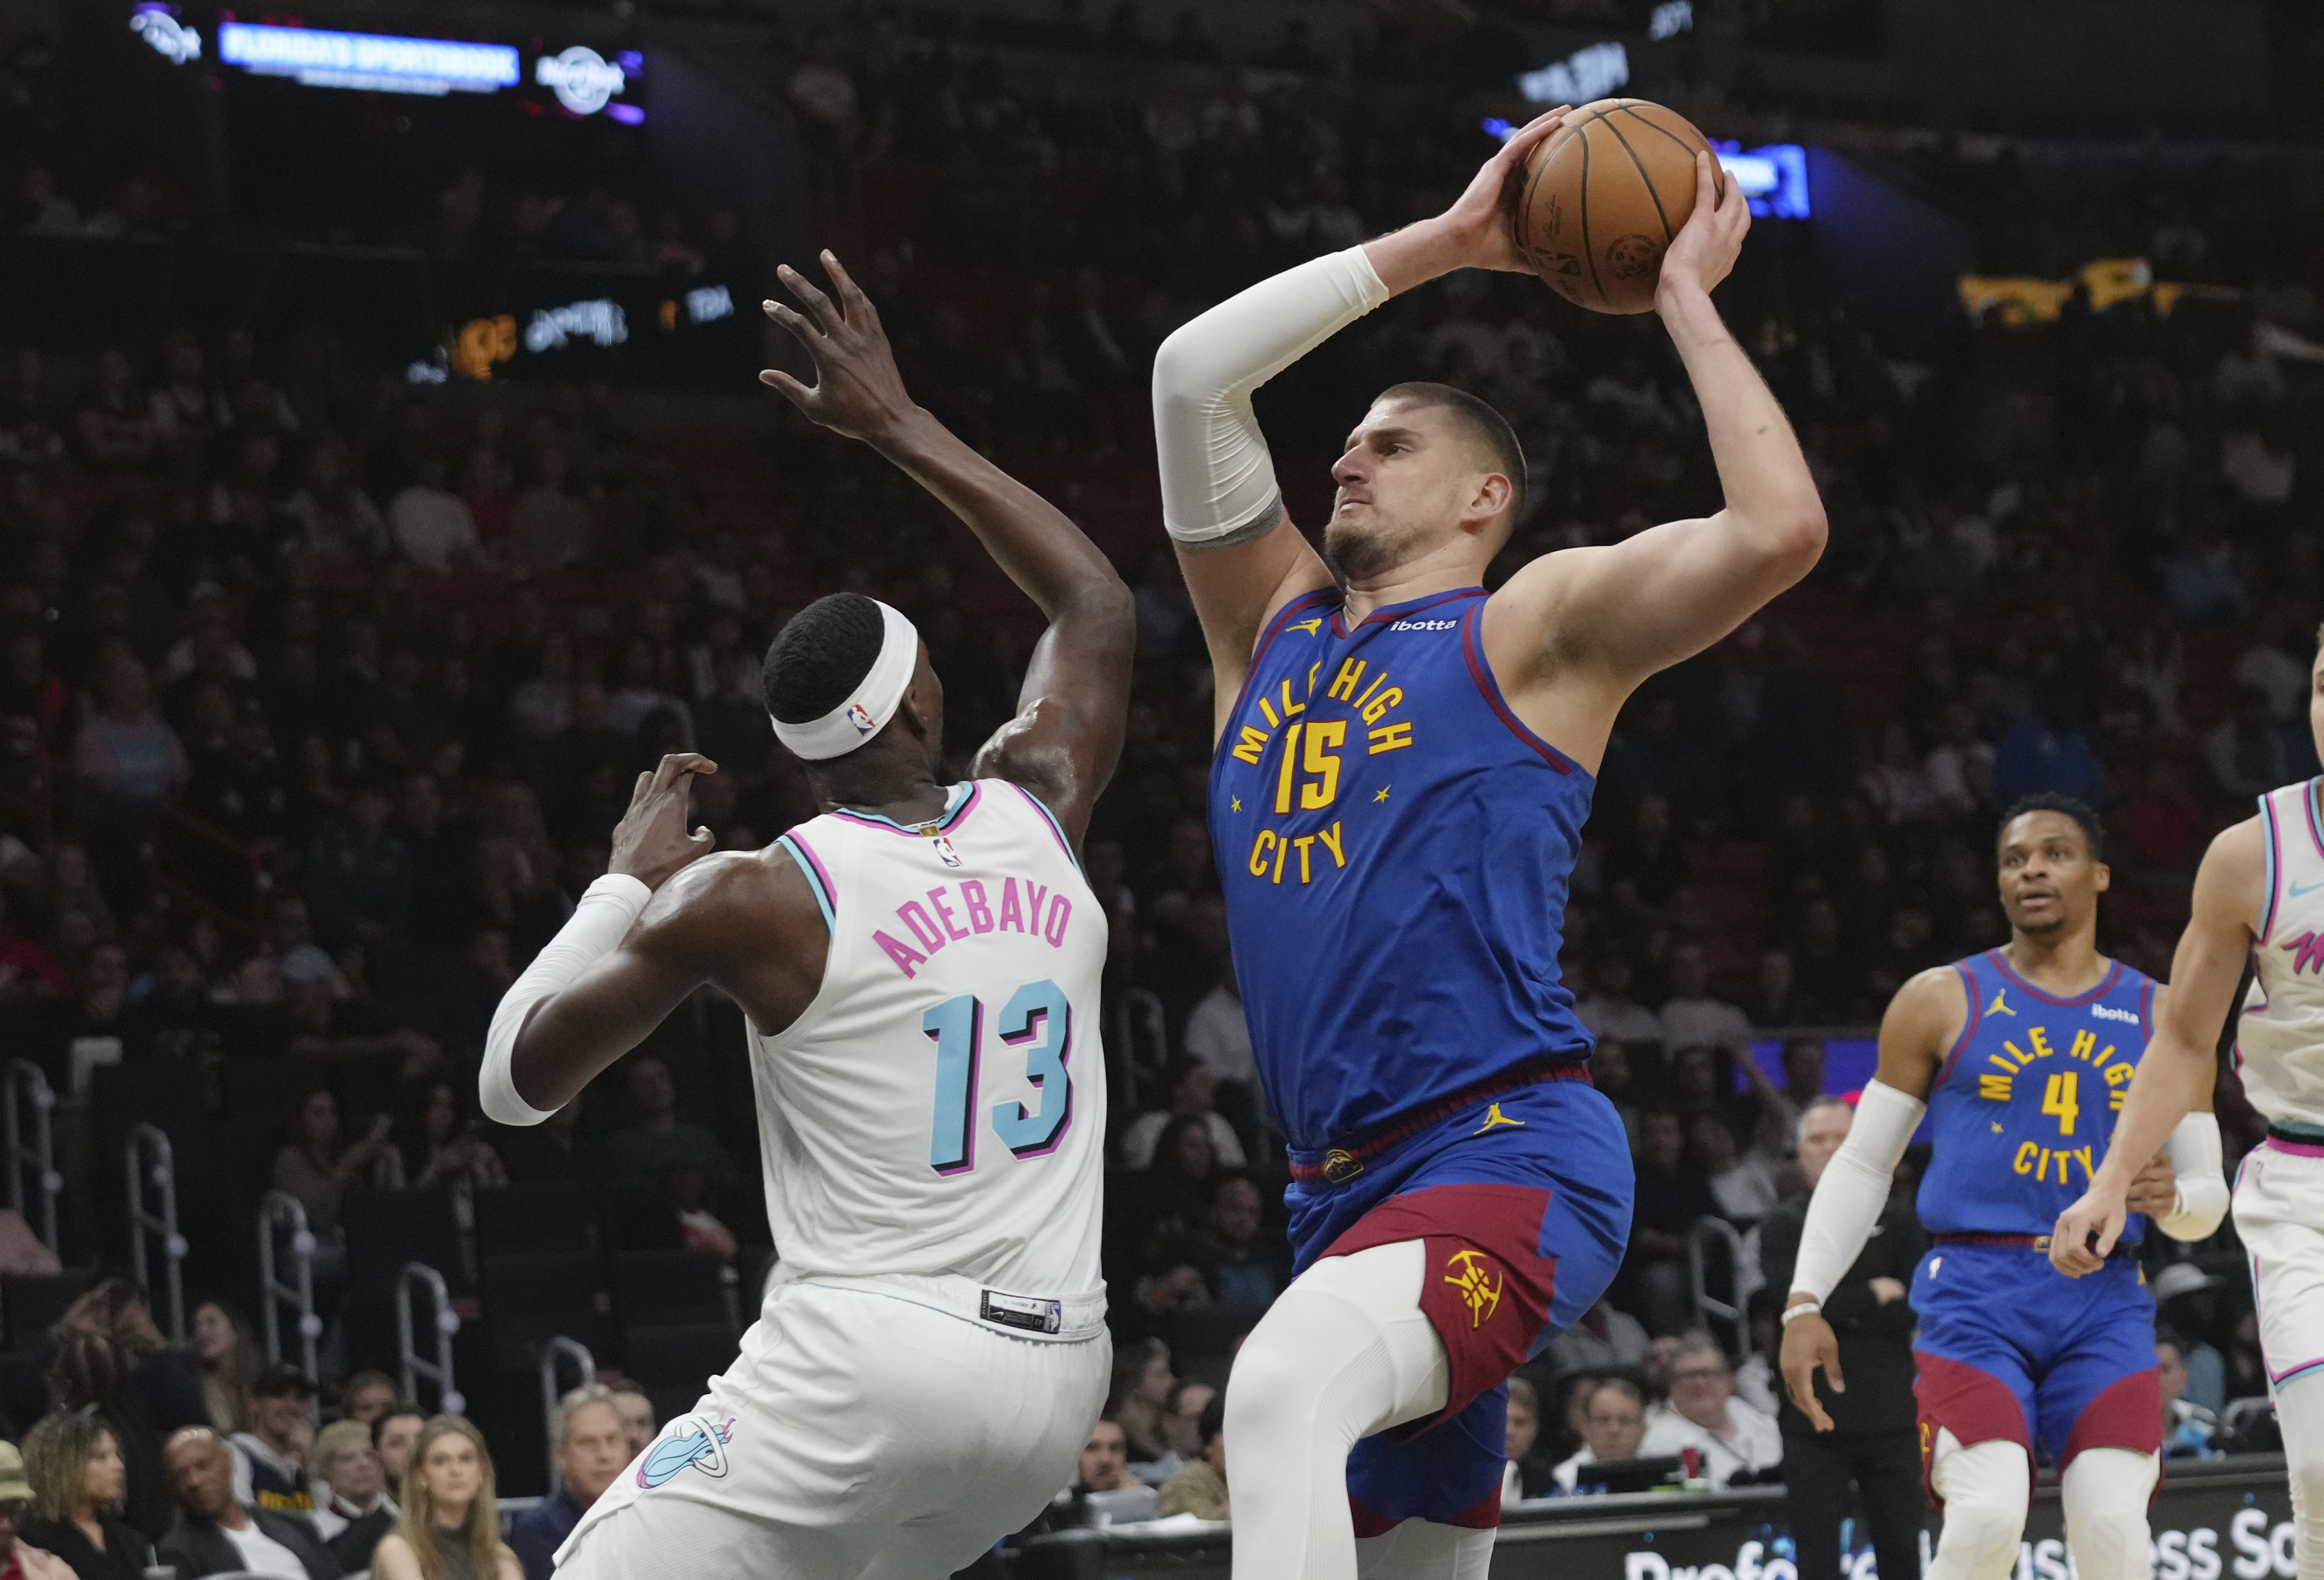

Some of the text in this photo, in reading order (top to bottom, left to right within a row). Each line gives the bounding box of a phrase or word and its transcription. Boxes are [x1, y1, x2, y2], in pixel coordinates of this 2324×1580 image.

[1390, 620, 1457, 631] ibotta
[1327, 657, 1412, 756] HIGH
[1275, 720, 1347, 813] 15
[1249, 821, 1346, 884] CITY
[872, 877, 1072, 979] ADEBAYO
[2091, 1003, 2139, 1025] ibotta
[922, 979, 1074, 1177] 13
[1979, 1026, 2053, 1101] MILE
[2042, 1071, 2079, 1135] 4
[2013, 1141, 2095, 1184] CITY
